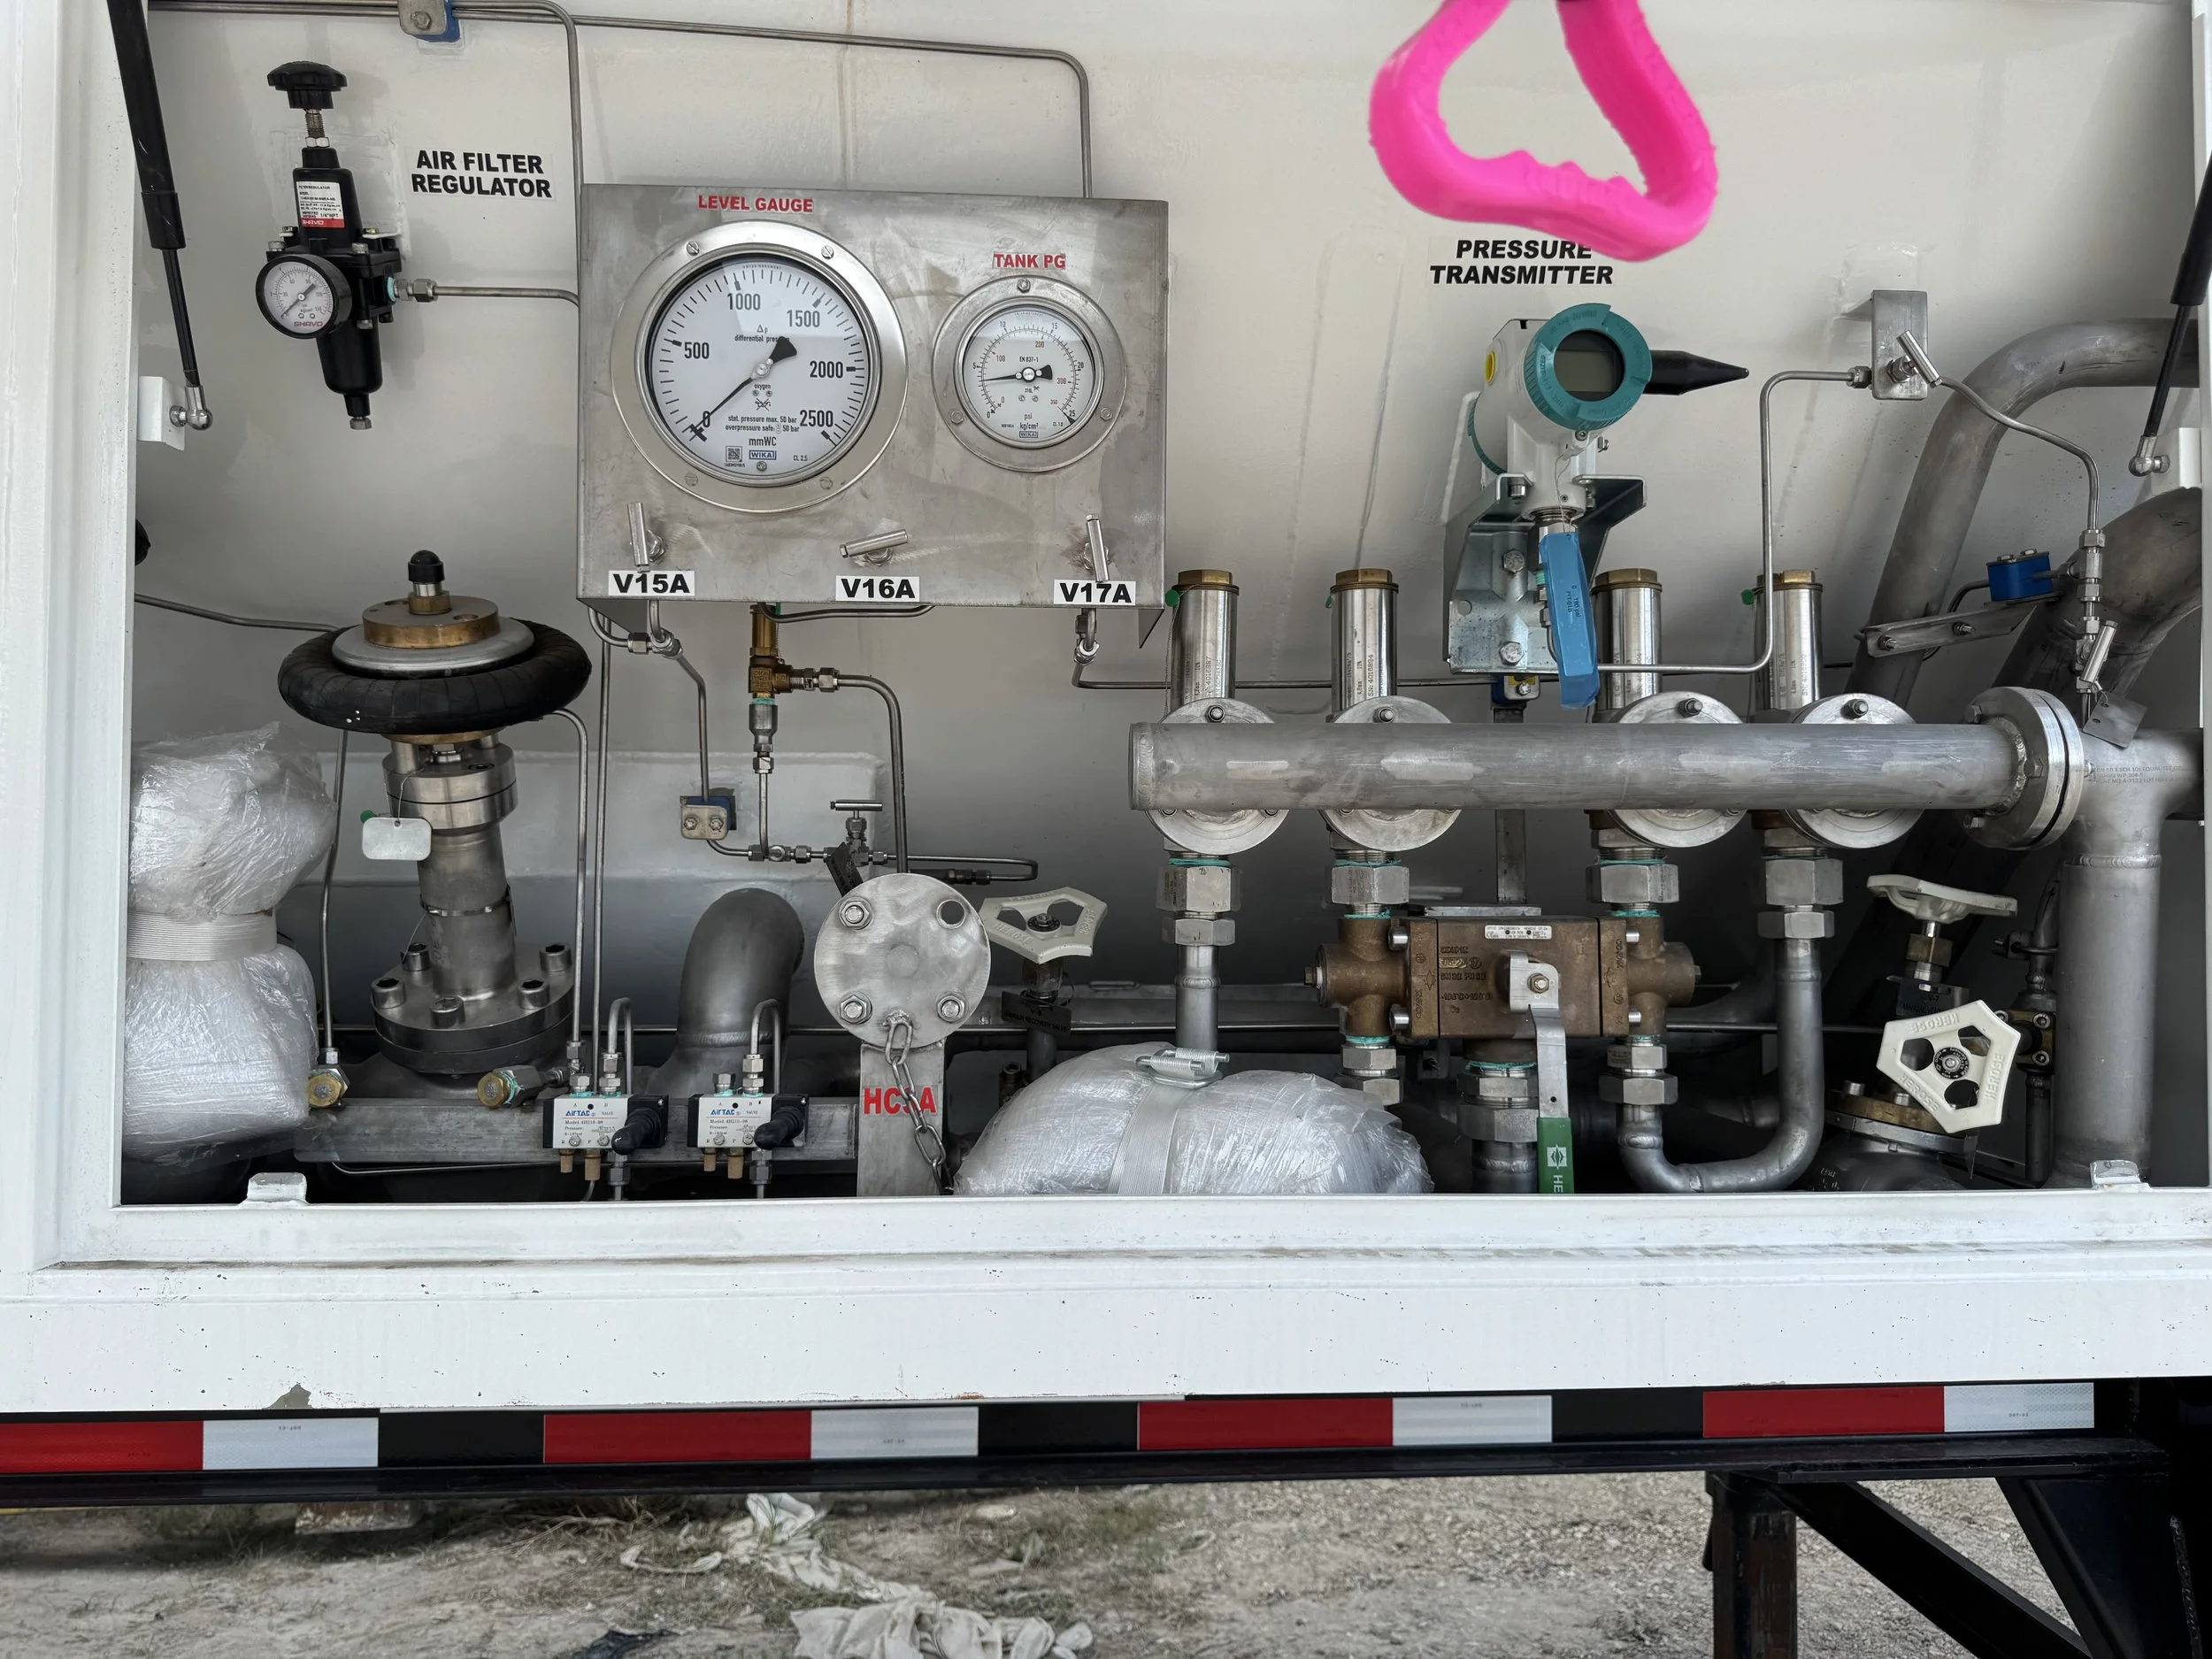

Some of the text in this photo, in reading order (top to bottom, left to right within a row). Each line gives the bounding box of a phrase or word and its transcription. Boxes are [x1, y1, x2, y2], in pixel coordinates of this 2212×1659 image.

[416, 150, 544, 174] AIR FILTER
[411, 173, 552, 198] REGULATOR
[699, 194, 813, 212] LEVEL GAUGE
[1456, 240, 1592, 259] PRESSURE
[994, 254, 1066, 269] TANK PG
[1430, 265, 1613, 285] TRANSMITTER
[727, 293, 761, 310] 1000
[787, 310, 820, 328] 1500
[684, 342, 710, 359] 500
[810, 361, 843, 378] 2000
[703, 411, 710, 427] 0
[800, 410, 833, 427] 2500
[749, 437, 776, 446] mmWC
[613, 572, 691, 594] V15A
[841, 578, 917, 599] V16A
[1059, 582, 1132, 603] V17A
